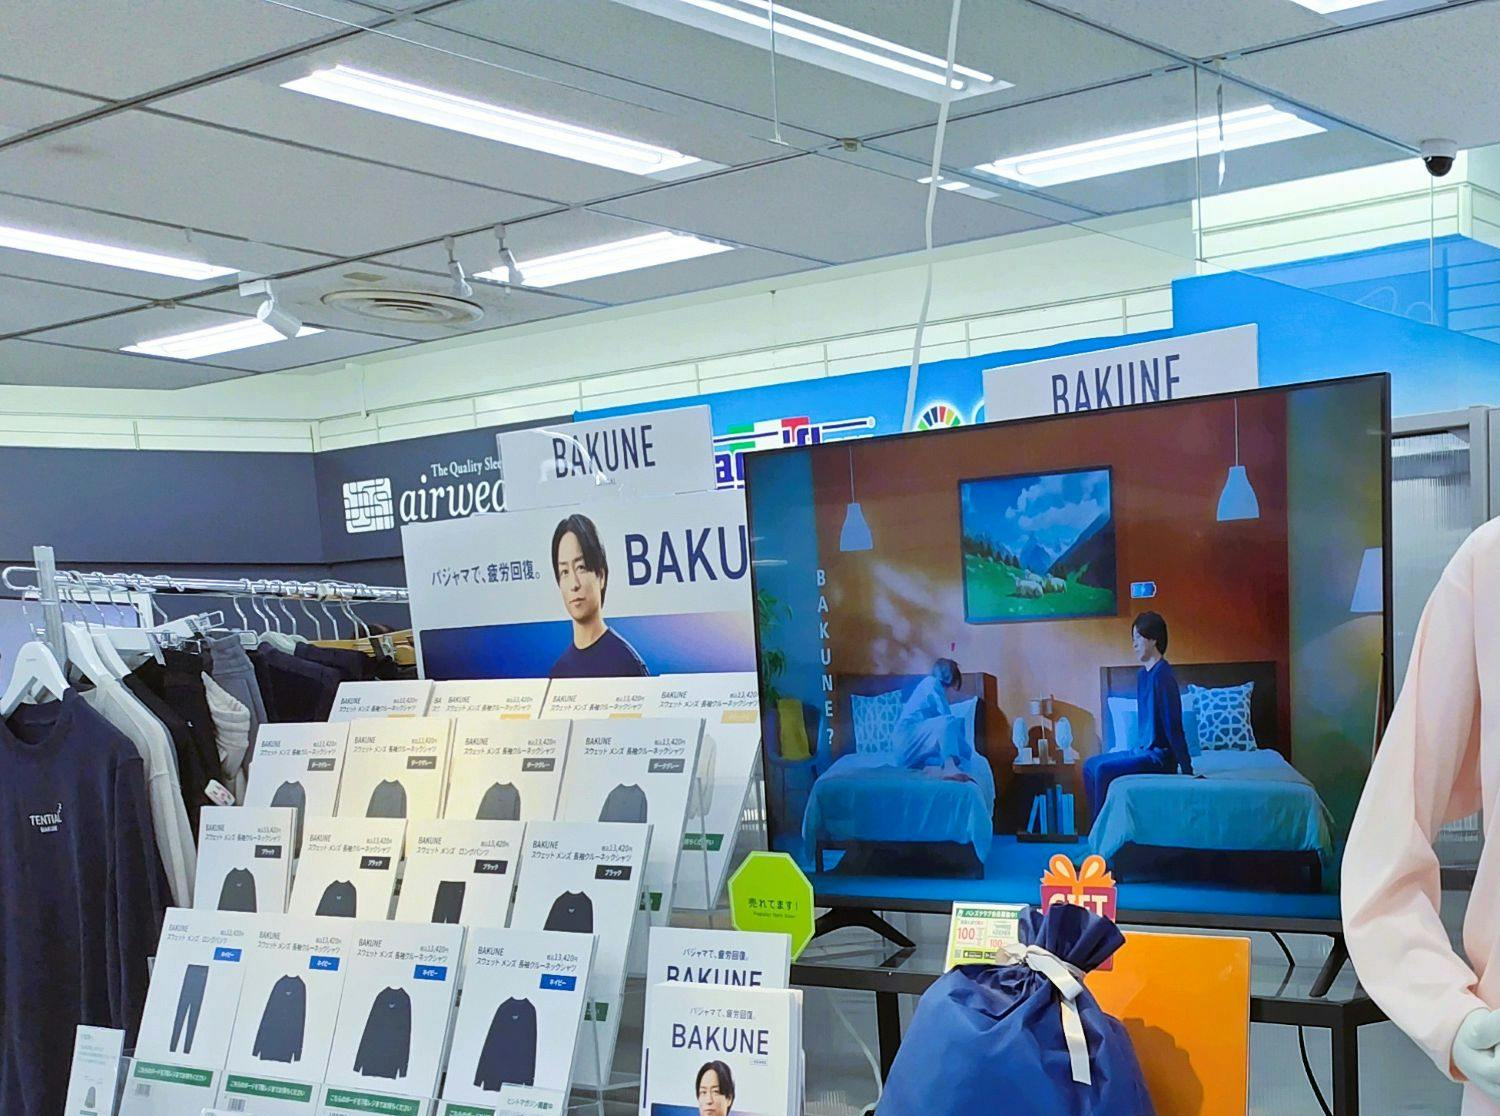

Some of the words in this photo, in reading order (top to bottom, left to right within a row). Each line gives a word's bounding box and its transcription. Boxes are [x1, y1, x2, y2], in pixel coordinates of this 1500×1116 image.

[1051, 354, 1180, 413] BAKUNE
[552, 425, 656, 478] BAKUNE
[431, 464, 449, 477] The
[450, 460, 483, 477] Quality
[431, 559, 542, 587] パジャマで、疲労回復。
[585, 737, 612, 745] BAKUNE
[28, 811, 62, 827] TENTIAL
[418, 836, 442, 845] BAKUNE
[532, 840, 559, 849] BAKUNE
[958, 928, 976, 940] 100
[358, 938, 382, 948] BAKUNE
[477, 946, 504, 957] BAKUNE
[667, 965, 763, 987] BAKUNE
[672, 1023, 769, 1055] BAKUNE
